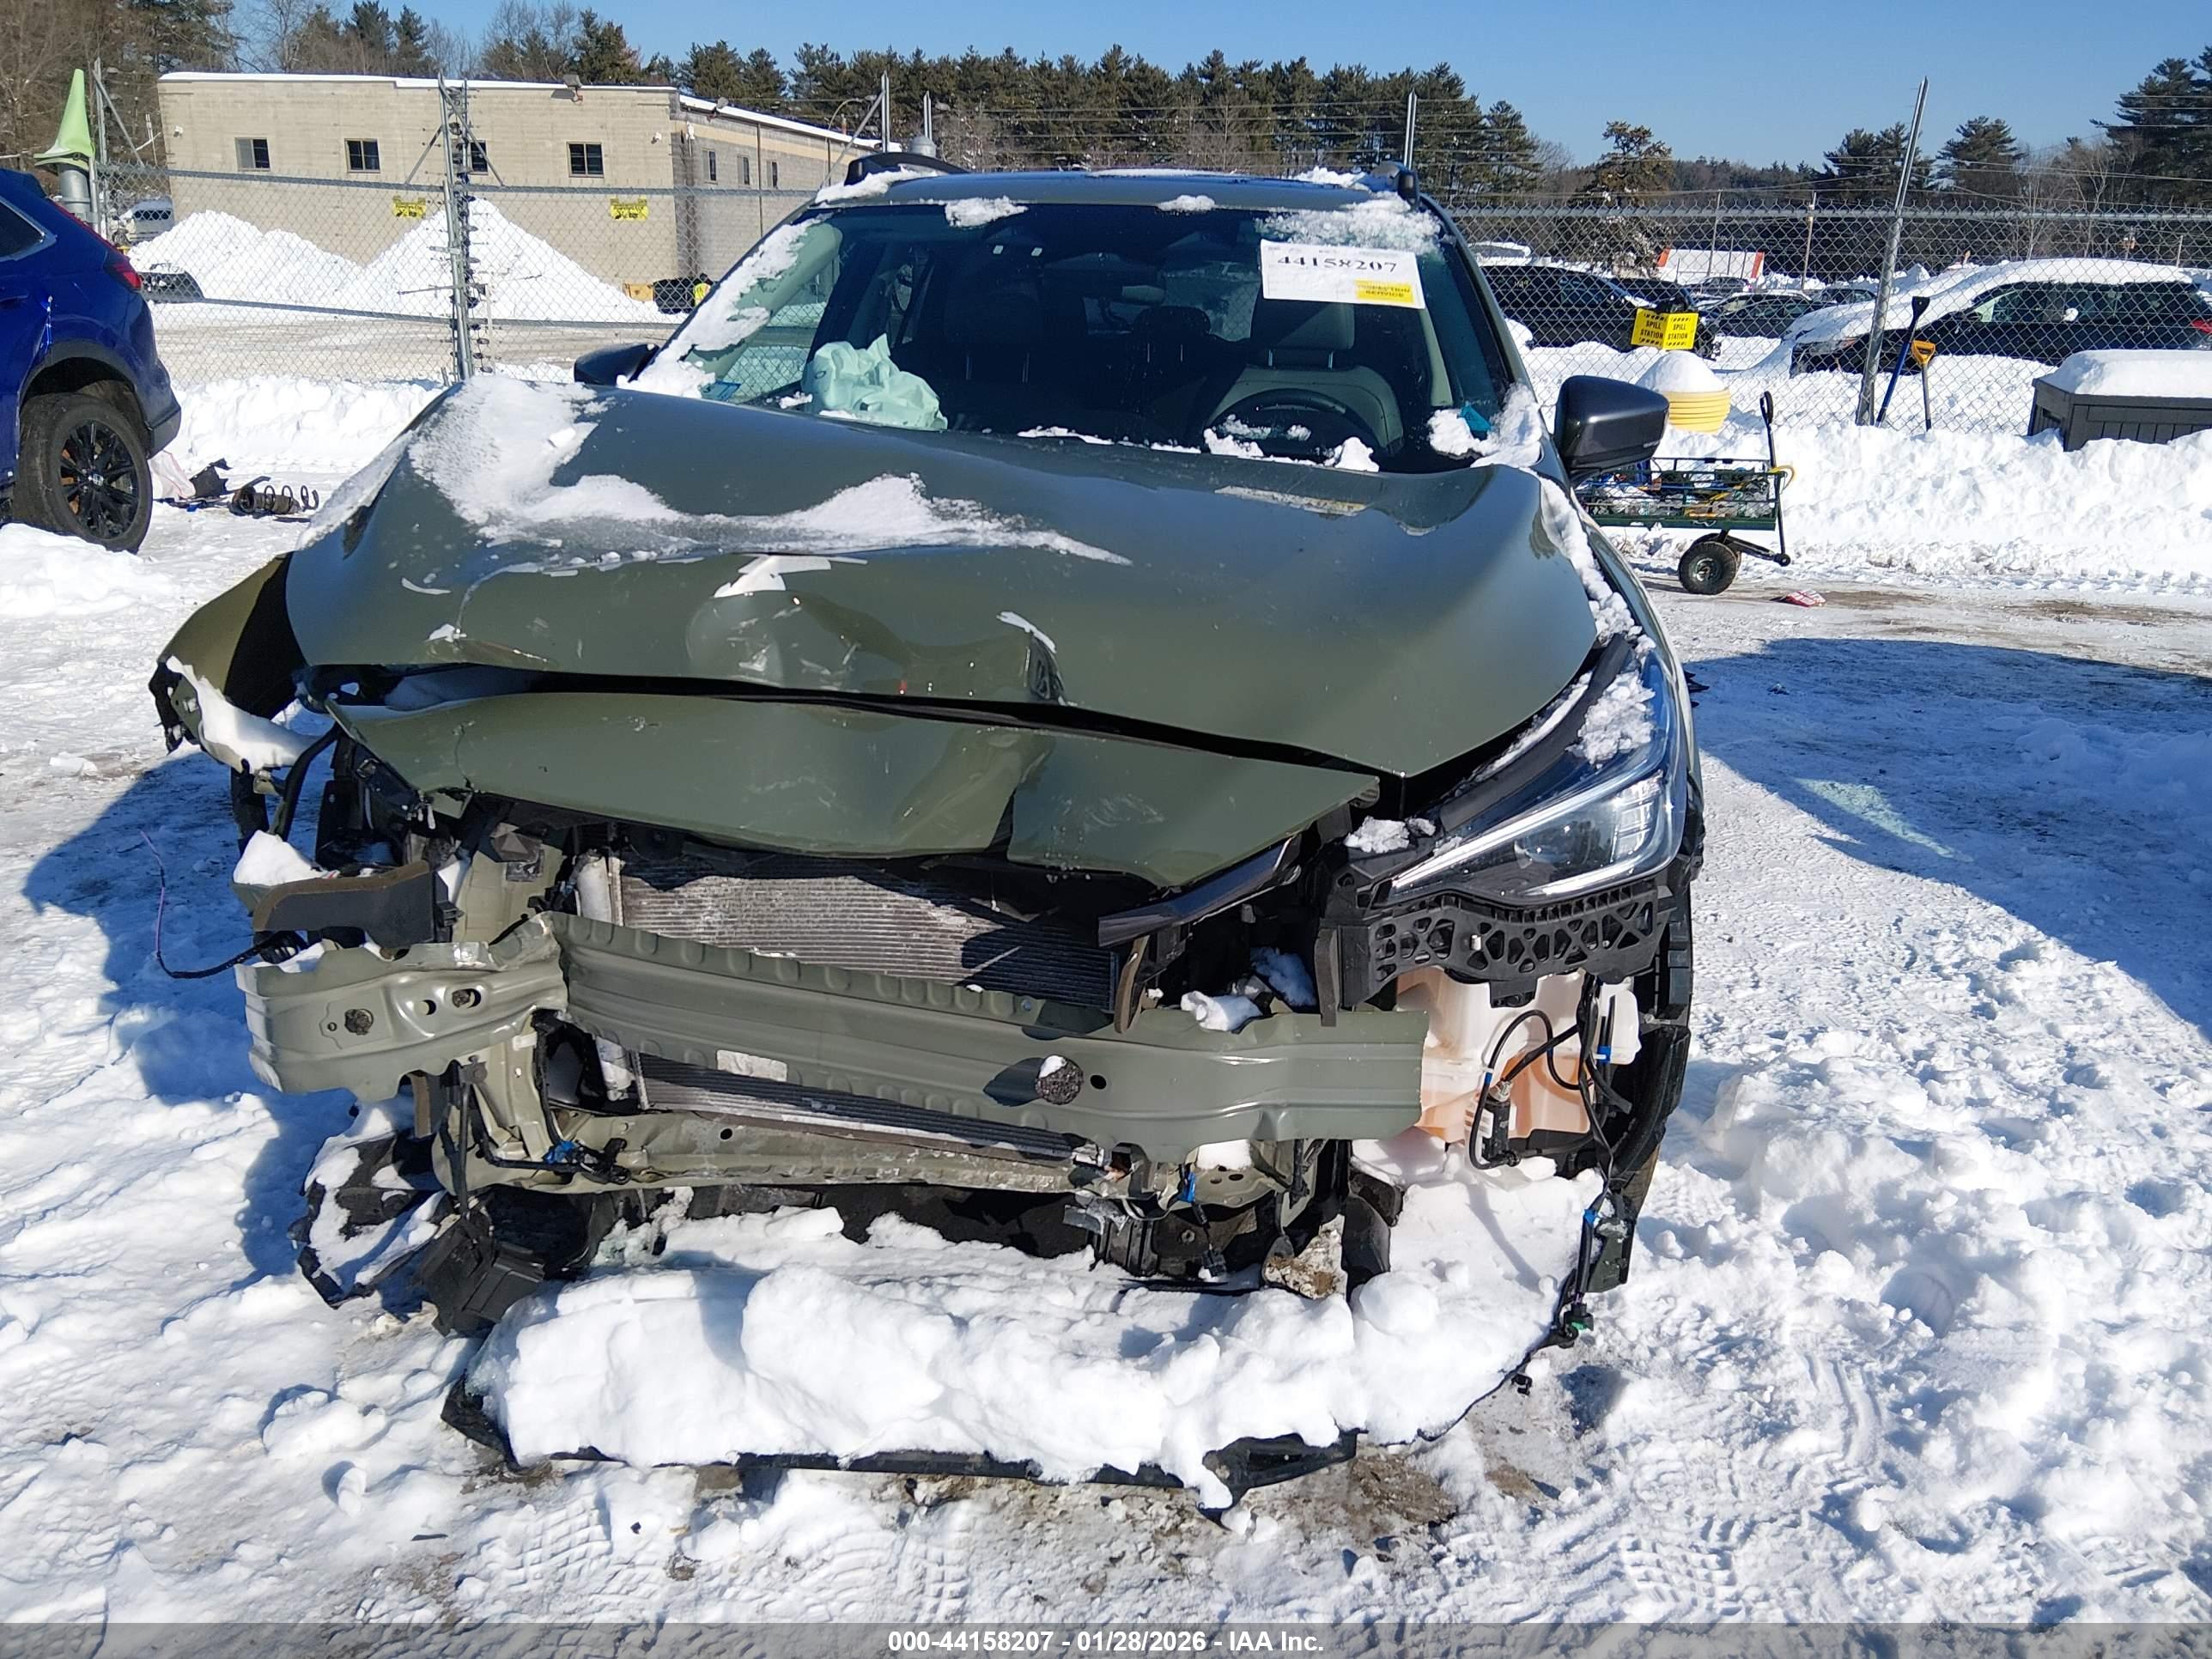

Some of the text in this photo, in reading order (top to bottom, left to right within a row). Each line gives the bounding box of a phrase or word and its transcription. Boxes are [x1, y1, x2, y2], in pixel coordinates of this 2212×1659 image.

[1277, 256, 1397, 273] 44158207
[1646, 320, 1661, 330] SPILL
[1640, 329, 1664, 339] STATION
